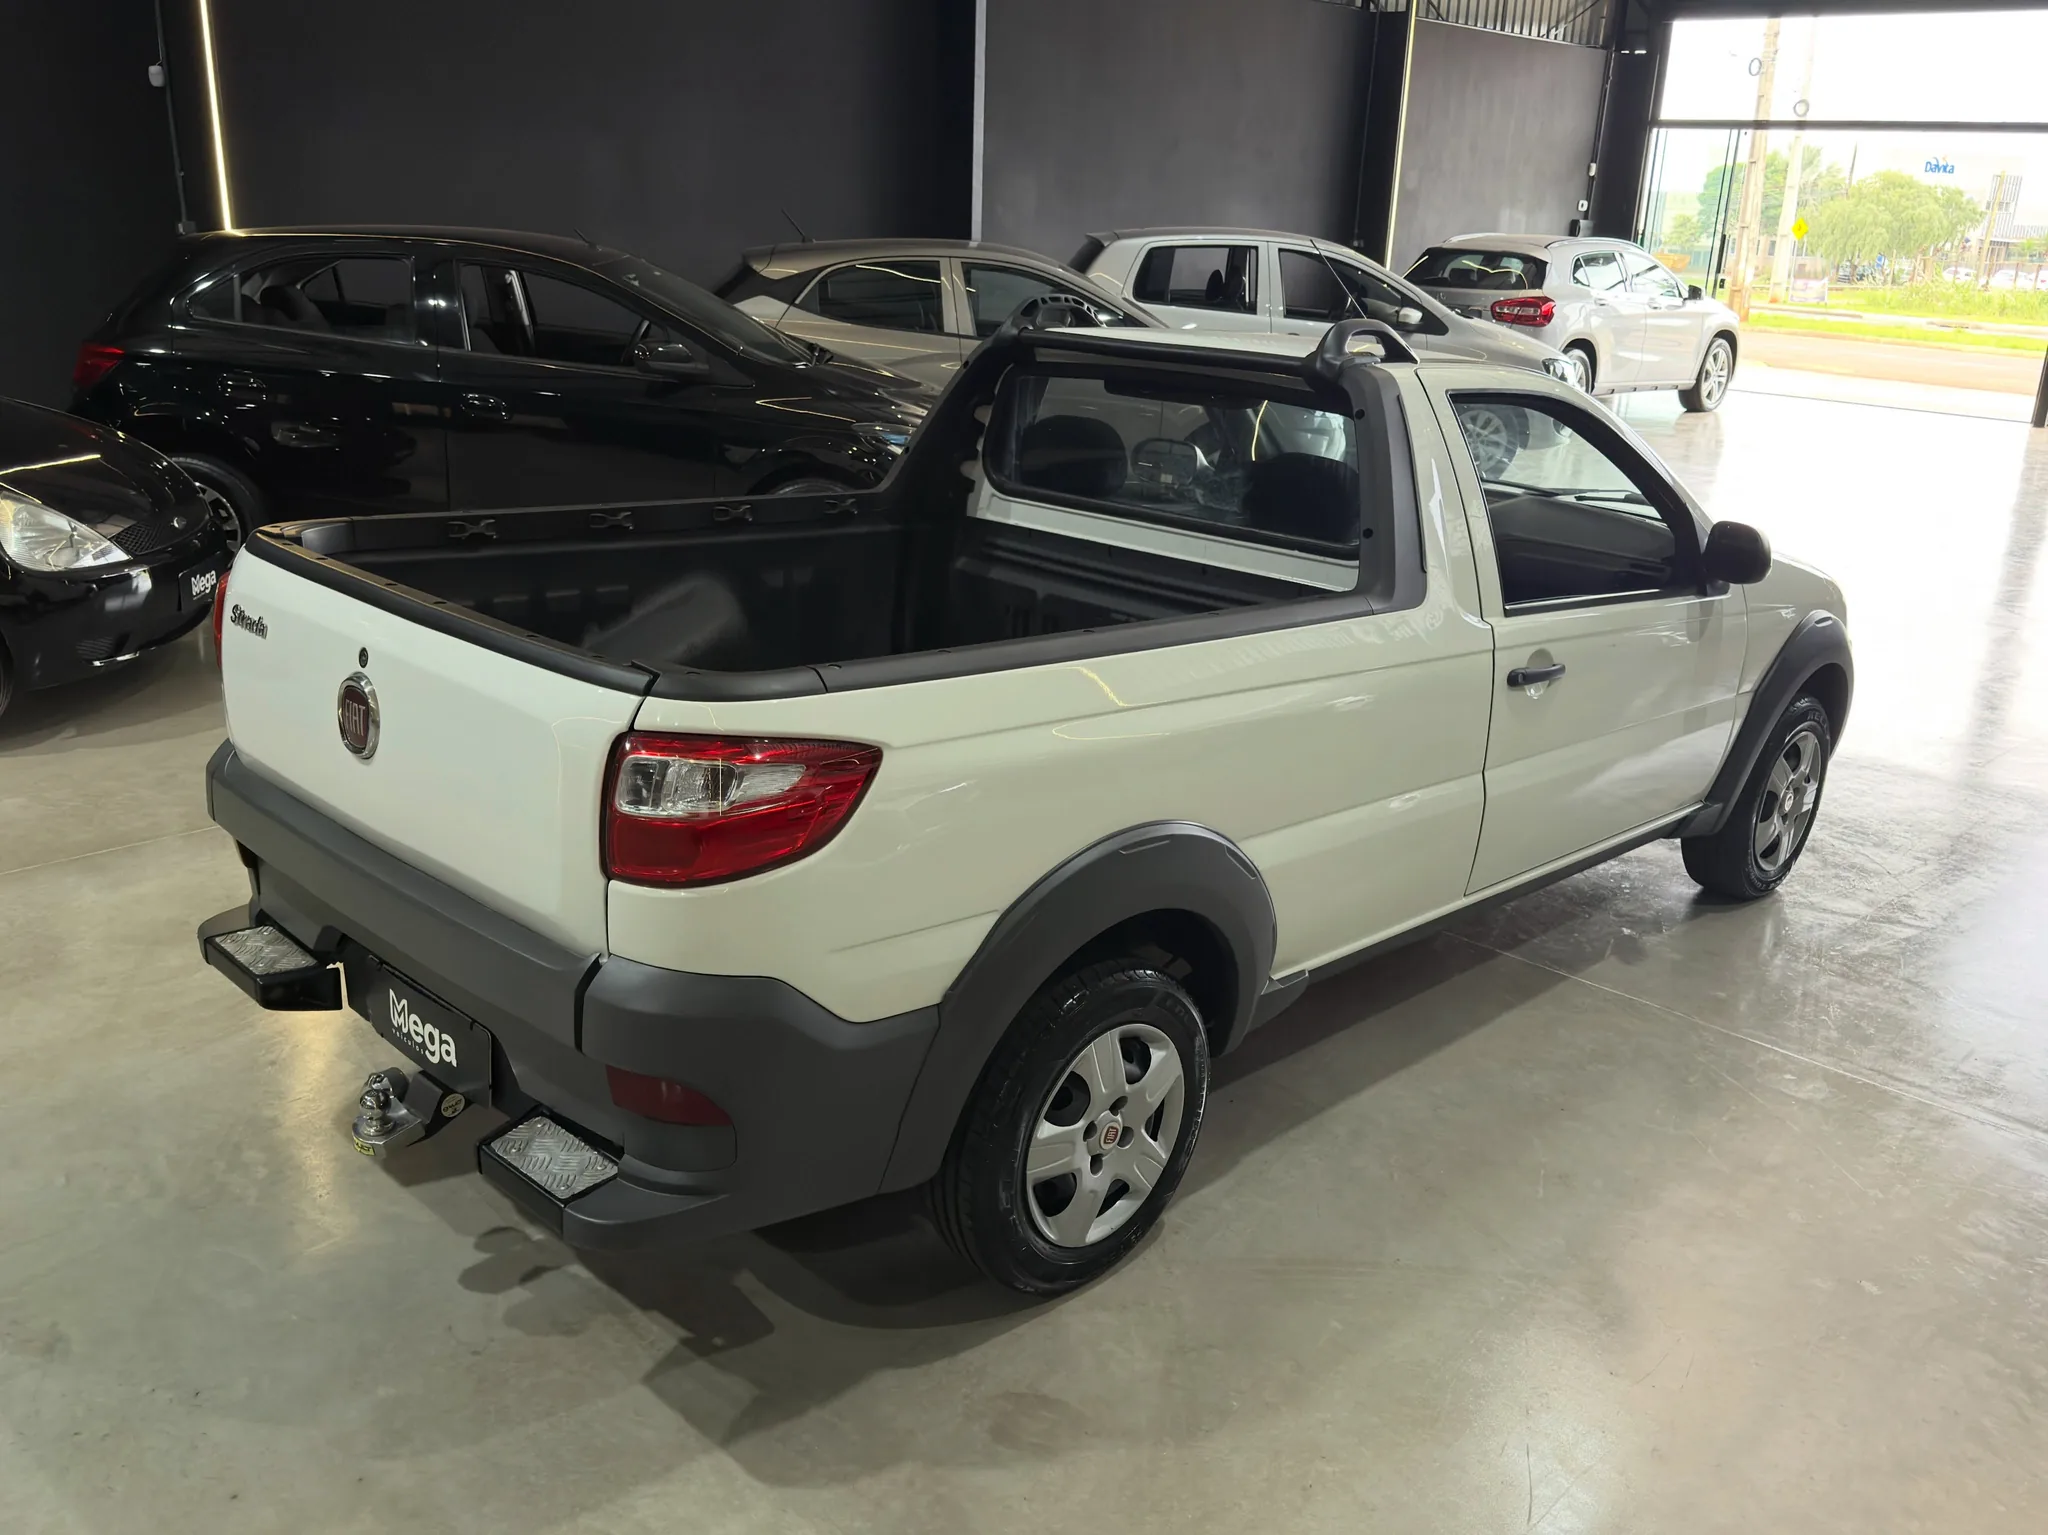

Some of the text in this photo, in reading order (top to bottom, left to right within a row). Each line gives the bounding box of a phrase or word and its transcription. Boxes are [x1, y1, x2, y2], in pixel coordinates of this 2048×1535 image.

[191, 570, 217, 596] Mega
[230, 604, 268, 640] Strada
[345, 698, 366, 737] FIAT
[389, 988, 458, 1068] Mega
[1105, 1128, 1117, 1143] FIAT
